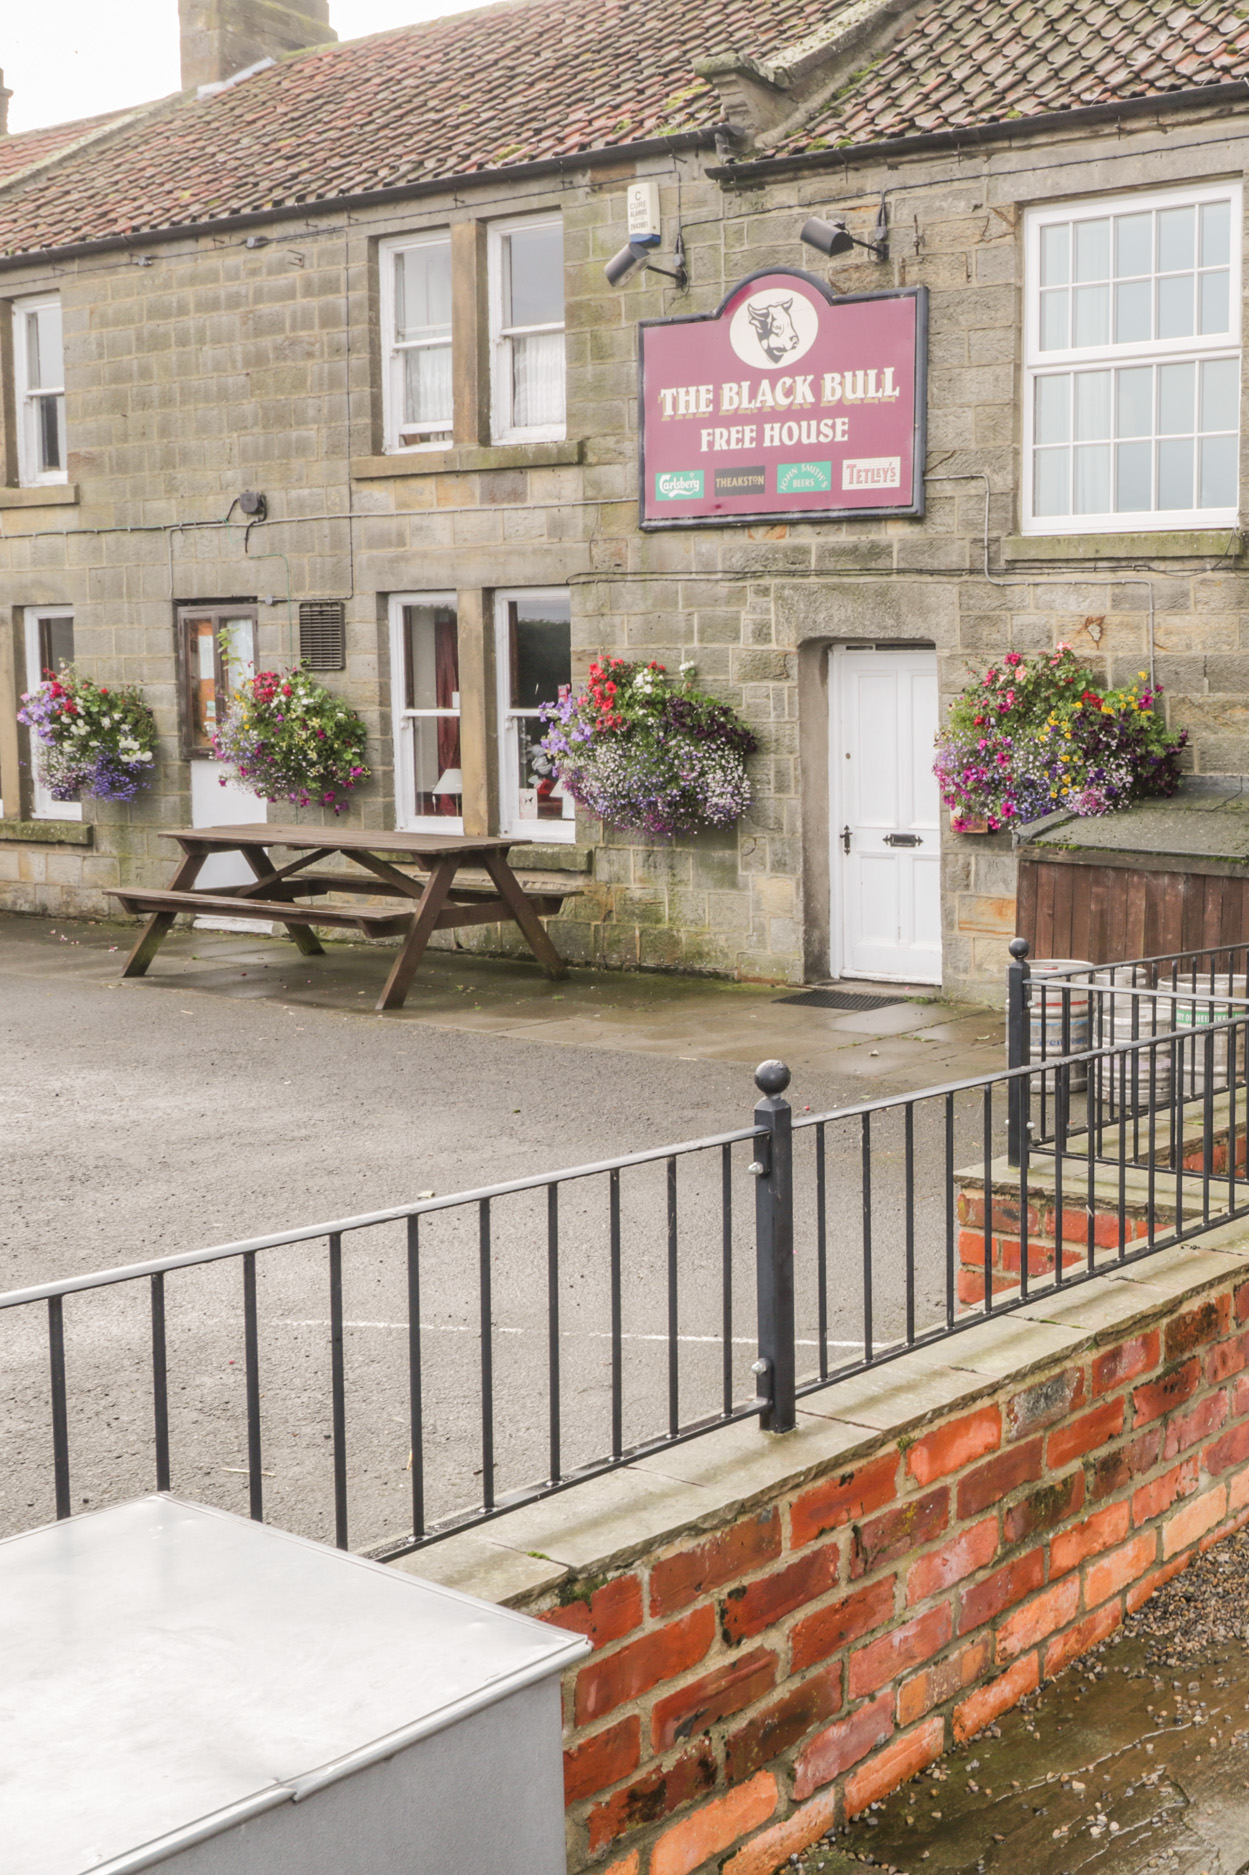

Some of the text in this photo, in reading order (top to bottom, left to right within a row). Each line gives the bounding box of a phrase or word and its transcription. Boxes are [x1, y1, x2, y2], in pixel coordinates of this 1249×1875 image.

[630, 200, 647, 210] CURE
[635, 191, 641, 201] C
[660, 366, 900, 416] THE BLACK BULL
[700, 417, 849, 452] FREE HOUSE
[715, 475, 765, 488] THEAKSTON
[779, 463, 828, 492] JOHN SMITH'S
[792, 478, 815, 488] BEERS
[846, 461, 897, 485] TETLEY'S
[659, 473, 700, 498] Carlsberg
